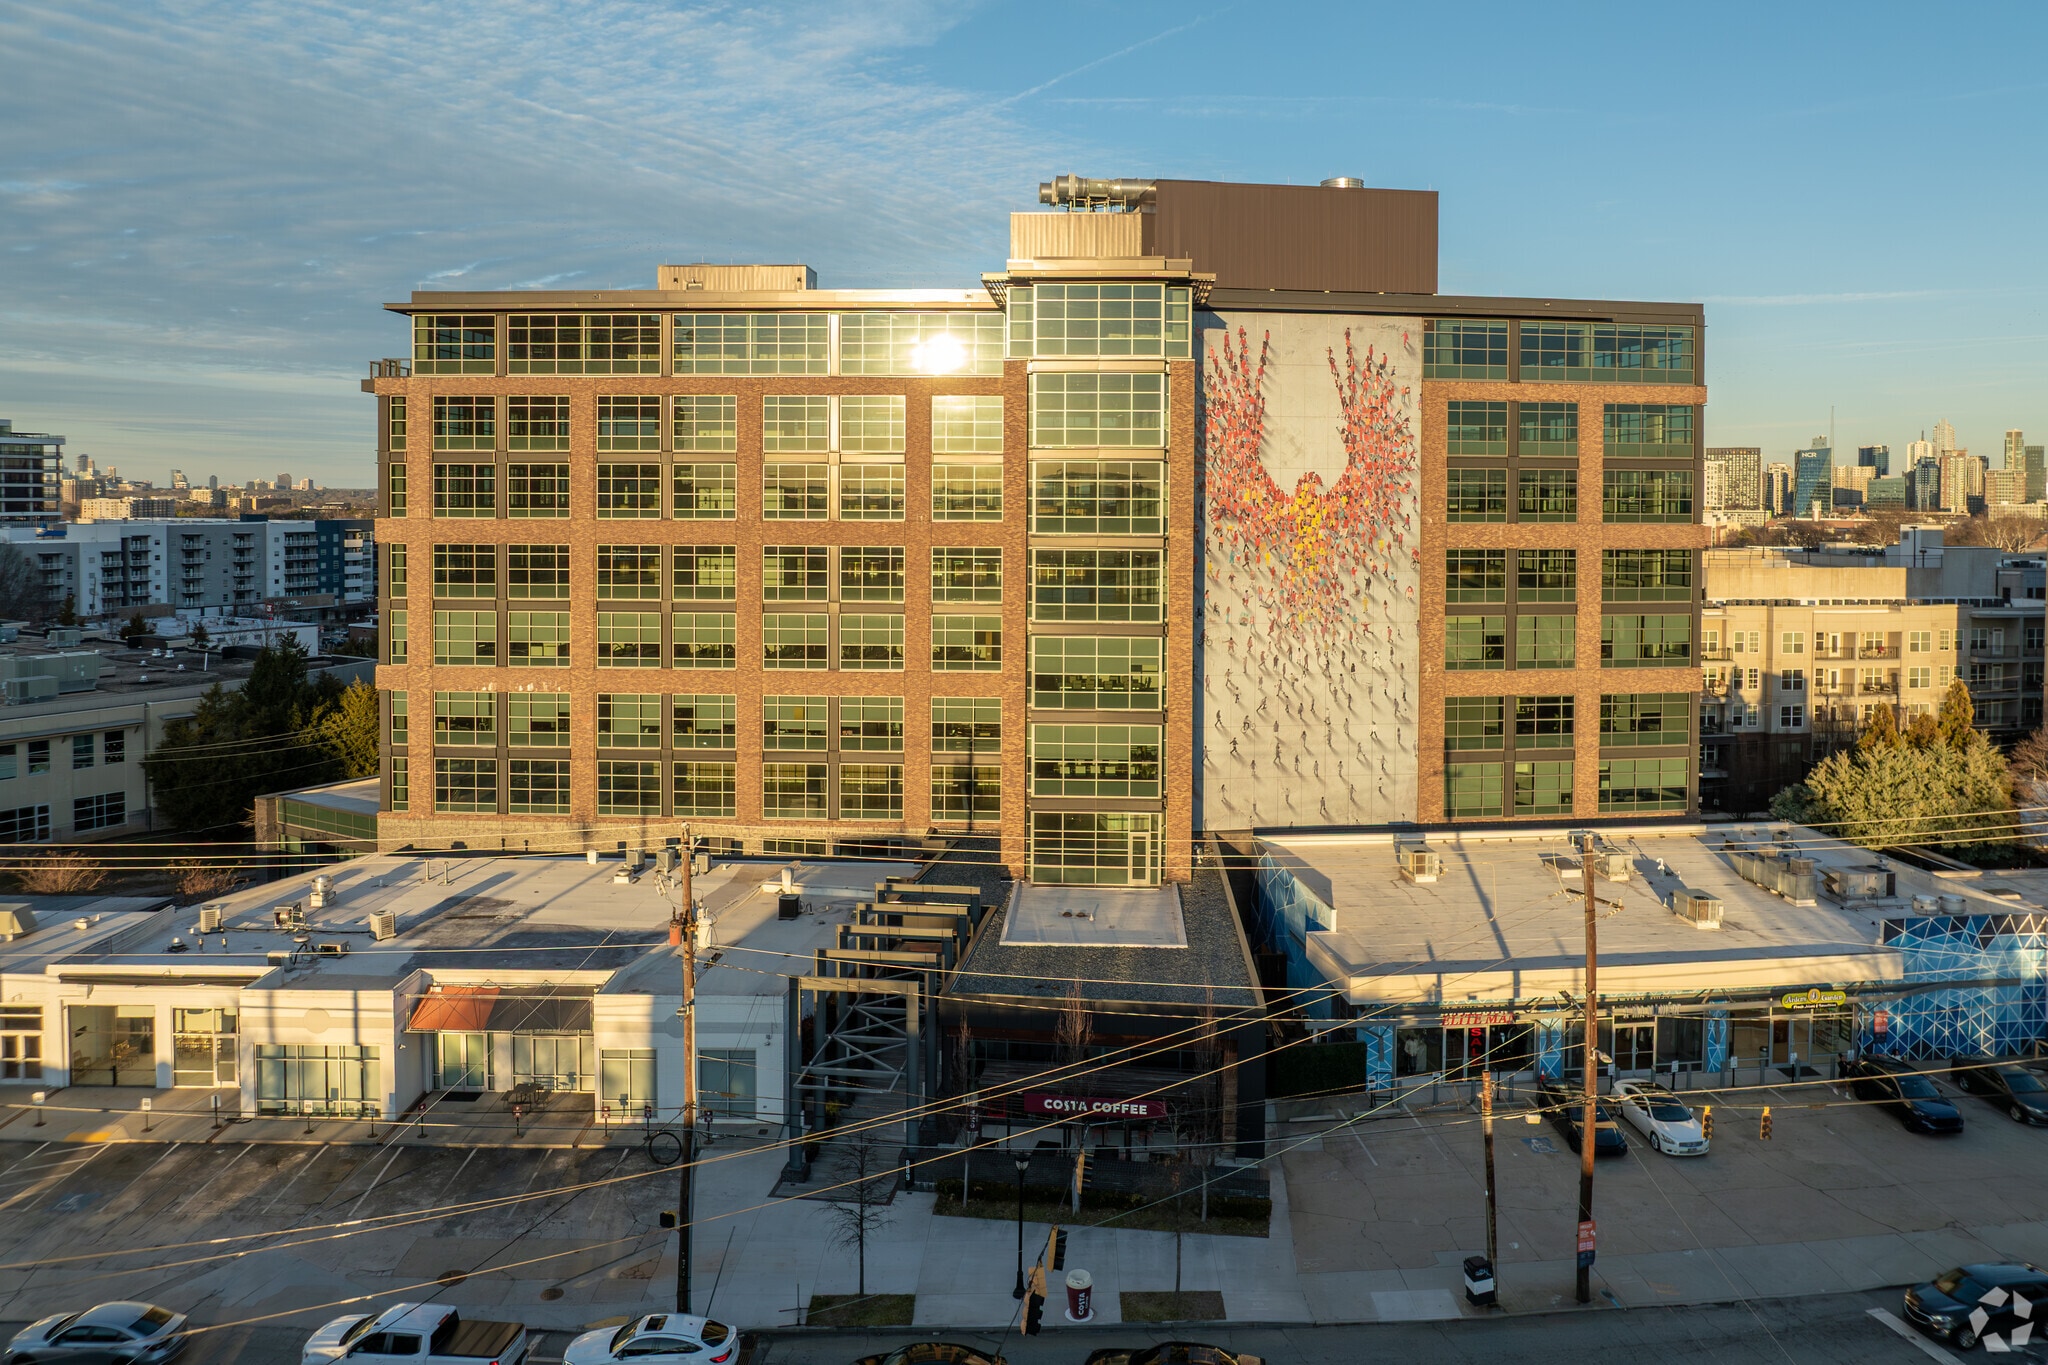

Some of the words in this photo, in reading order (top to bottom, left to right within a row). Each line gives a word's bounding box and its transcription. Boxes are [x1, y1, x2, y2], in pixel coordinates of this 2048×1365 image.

[1442, 1013, 1483, 1026] ELITE
[1043, 1099, 1088, 1111] COSTA
[1092, 1102, 1148, 1115] COFFEE
[1078, 1292, 1086, 1316] COSTA
